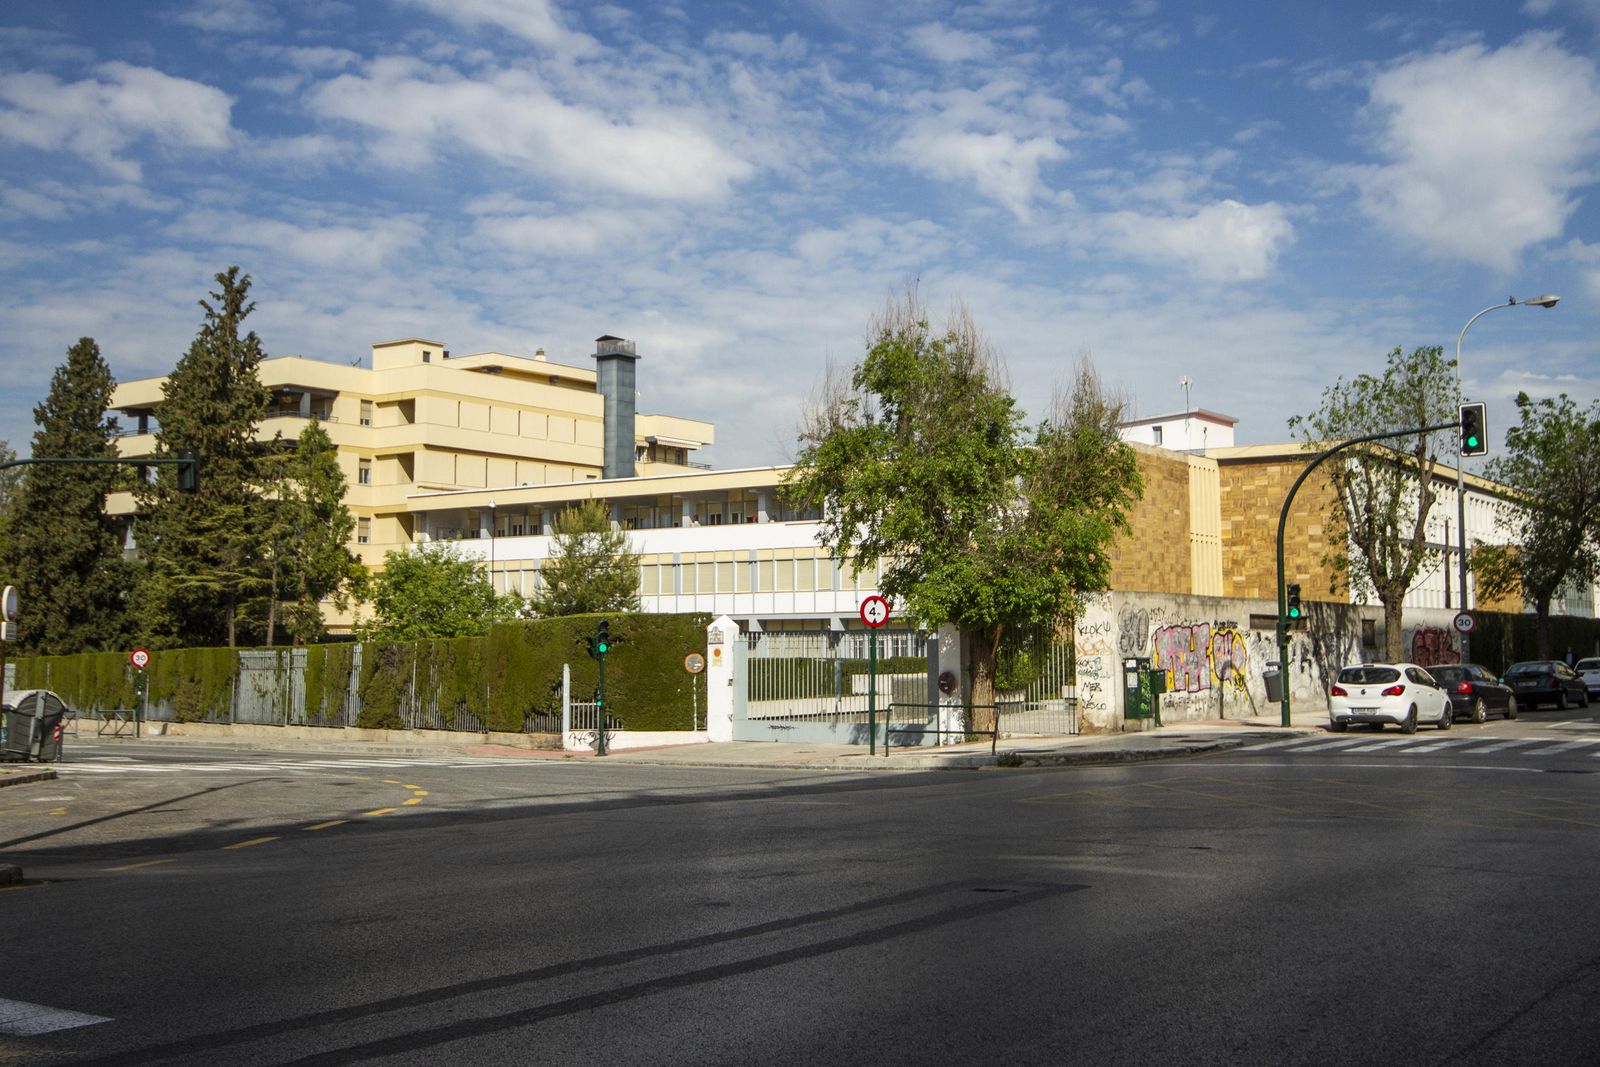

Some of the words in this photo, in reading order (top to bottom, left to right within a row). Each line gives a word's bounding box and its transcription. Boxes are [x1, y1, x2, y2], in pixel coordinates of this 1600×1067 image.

[869, 607, 876, 616] 4
[1458, 618, 1471, 627] 30
[135, 654, 146, 662] 30
